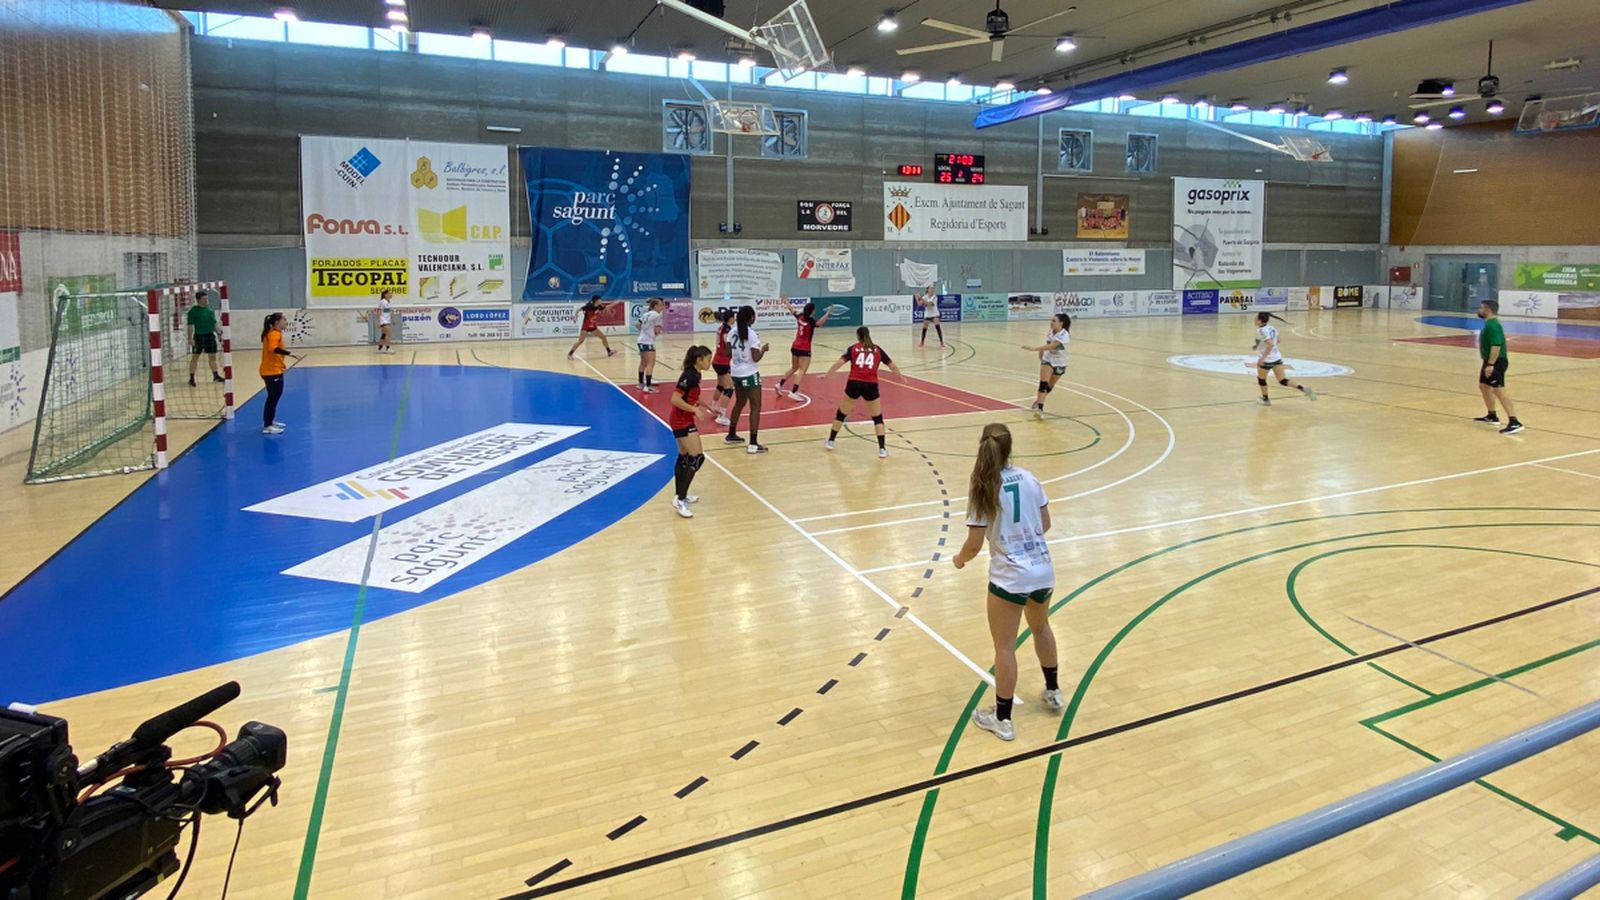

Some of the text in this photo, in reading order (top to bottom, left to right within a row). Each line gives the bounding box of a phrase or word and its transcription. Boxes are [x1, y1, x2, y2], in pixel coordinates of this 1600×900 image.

[339, 160, 365, 186] MODEL
[940, 172, 952, 182] 25
[971, 173, 983, 183] 24
[573, 191, 616, 208] parc
[915, 197, 1025, 211] Excm. Ajuntament de Sagunt
[1187, 188, 1250, 205] gasoprix
[552, 204, 617, 225] sagunt
[803, 223, 849, 231] MORVEDRE
[930, 218, 1007, 232] Regidoria d'Esports
[312, 260, 362, 268] FORJADOS
[370, 260, 407, 268] PLACAS
[418, 254, 460, 263] TECNODUR
[312, 268, 408, 287] TECOPAL
[1220, 295, 1254, 304] PAVASAL
[855, 352, 874, 369] 44
[378, 434, 521, 482] COMUNITAT
[417, 431, 557, 481] DE L'ESPORT
[557, 463, 602, 483] parc
[564, 466, 628, 495] sagunt
[1002, 483, 1021, 523] 7
[391, 531, 464, 563] parc
[391, 533, 496, 585] sagunt
